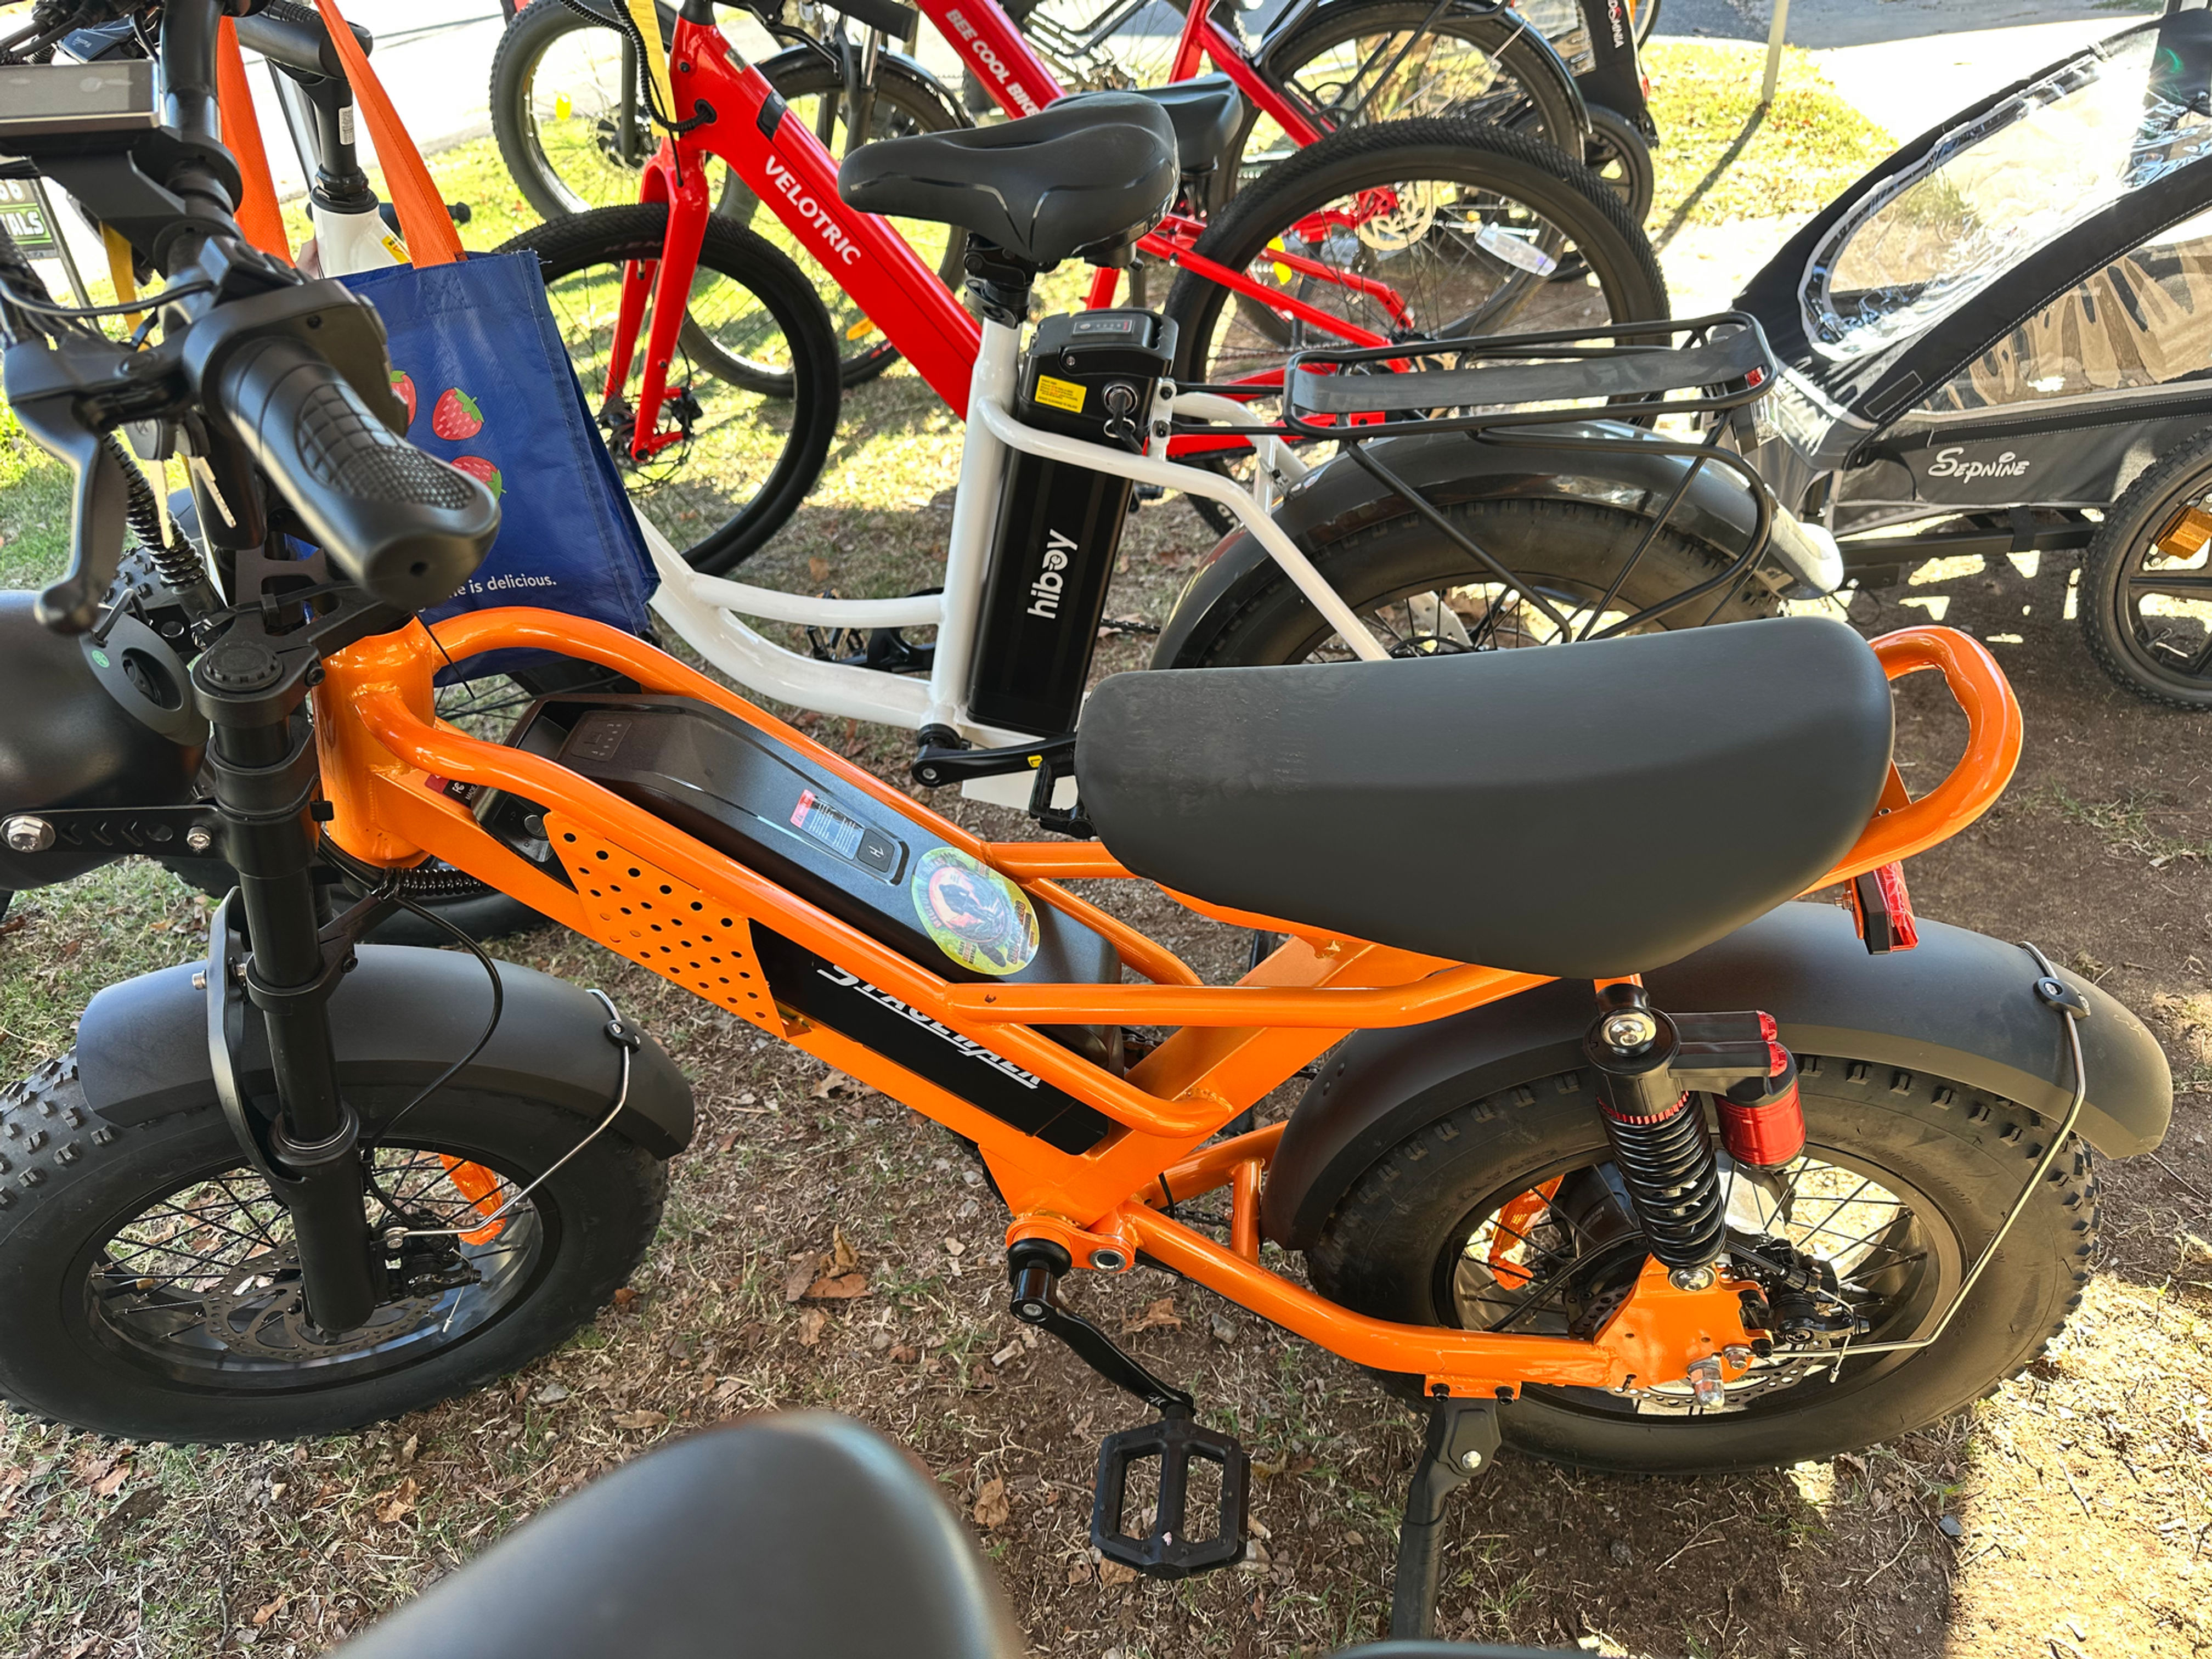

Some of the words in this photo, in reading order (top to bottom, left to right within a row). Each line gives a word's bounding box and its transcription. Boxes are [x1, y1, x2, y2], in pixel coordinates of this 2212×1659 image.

[945, 9, 978, 42] BEE
[972, 40, 1011, 84] COOL
[765, 155, 861, 265] VELOTRIC
[468, 579, 483, 594] is
[487, 573, 557, 591] delicious.
[1027, 528, 1078, 619] hiboy
